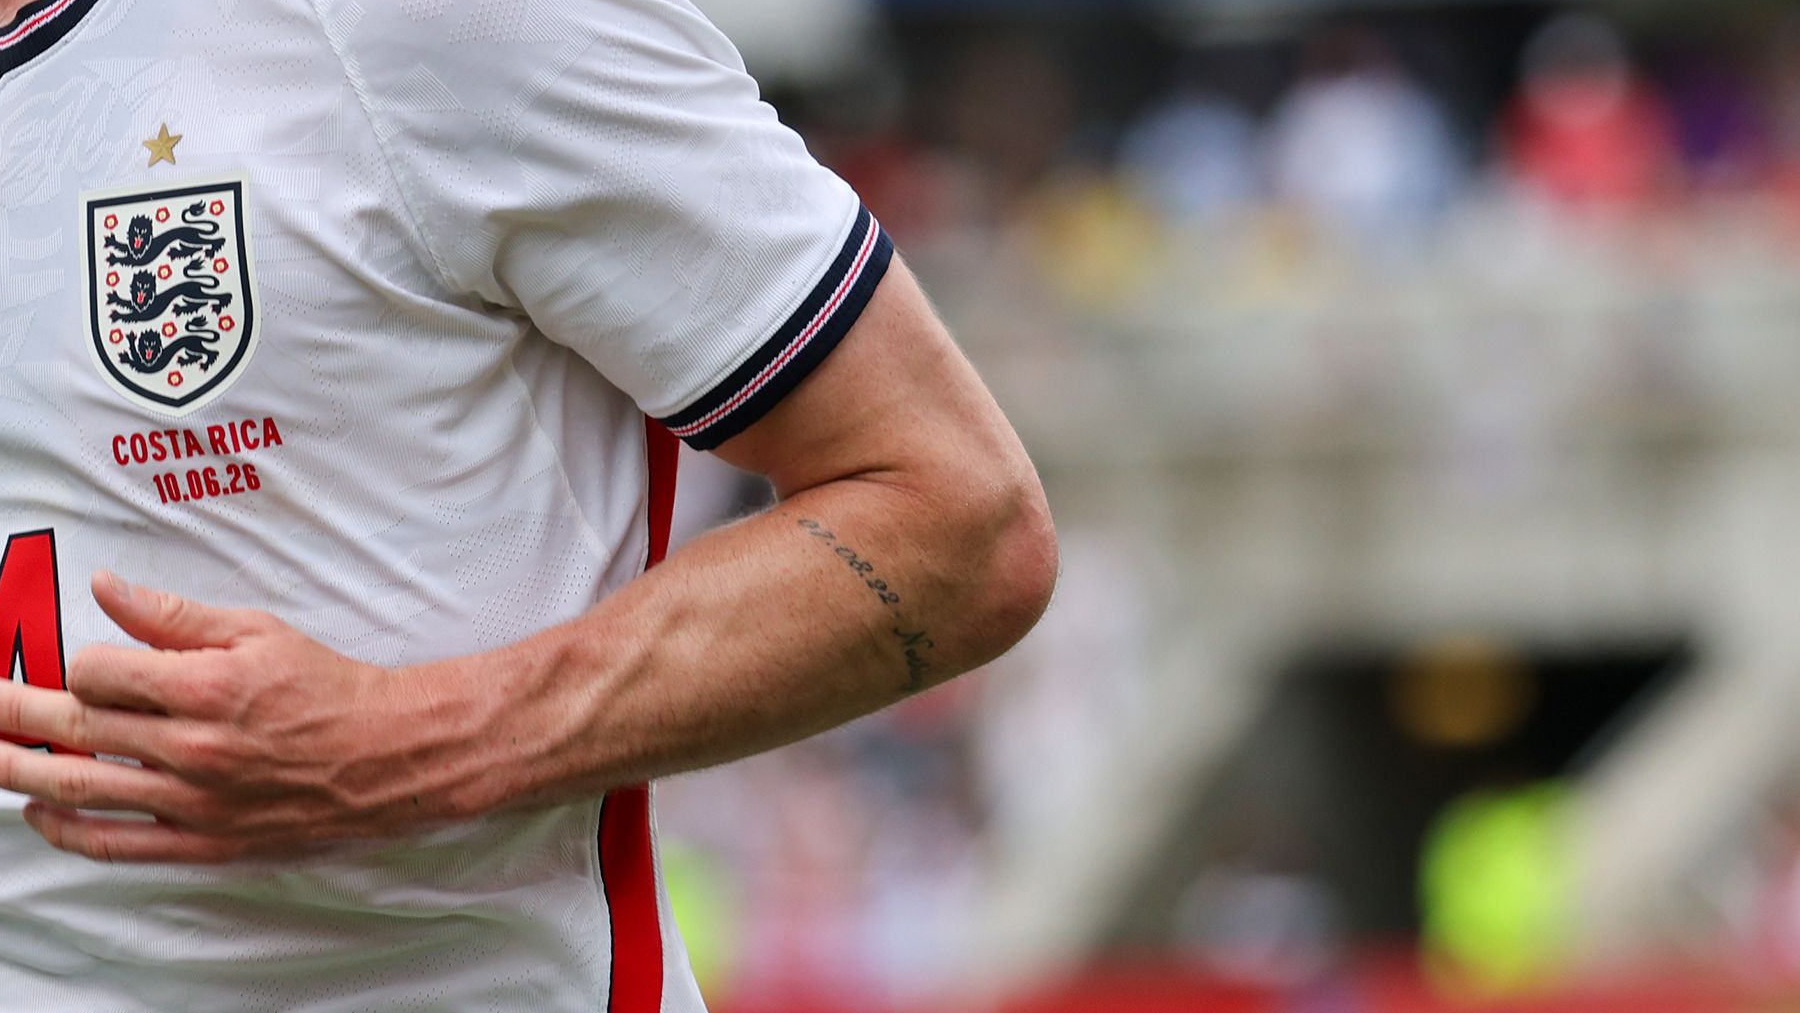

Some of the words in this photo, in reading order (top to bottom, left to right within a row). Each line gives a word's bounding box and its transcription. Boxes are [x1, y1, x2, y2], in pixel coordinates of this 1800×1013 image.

[112, 428, 205, 466] COSTA
[206, 417, 283, 456] RICA
[153, 463, 261, 505] 10.06.26
